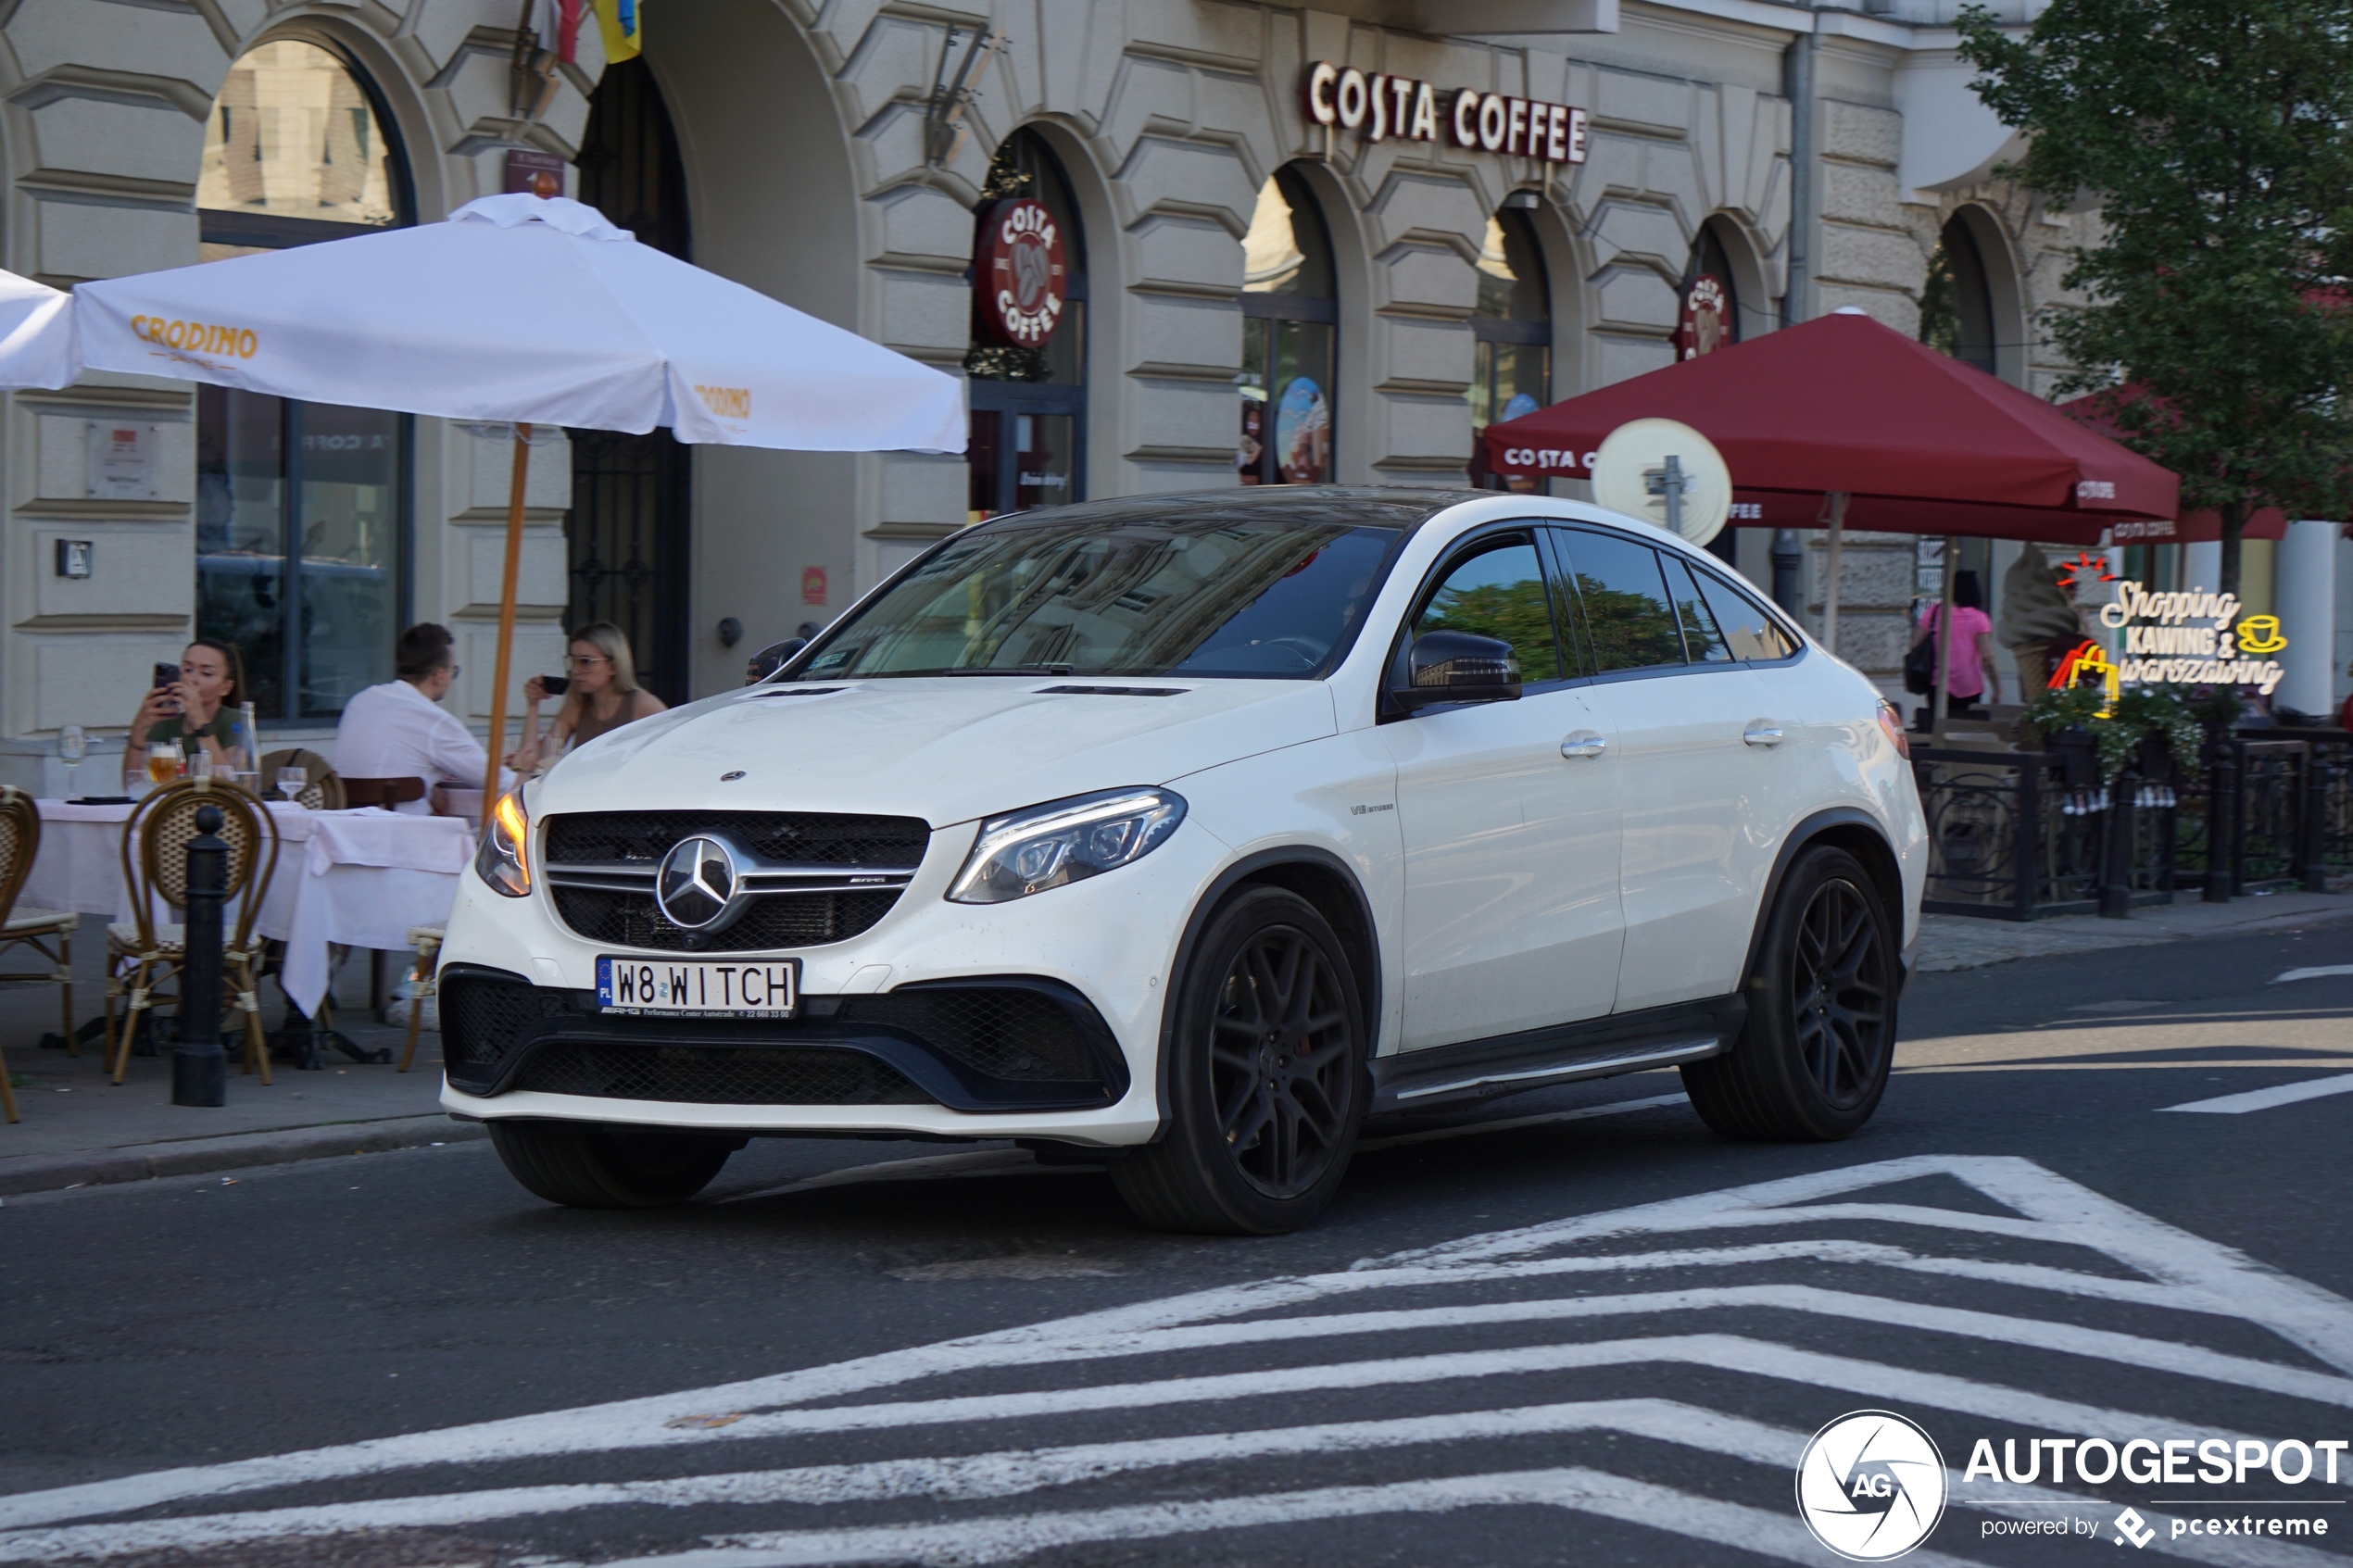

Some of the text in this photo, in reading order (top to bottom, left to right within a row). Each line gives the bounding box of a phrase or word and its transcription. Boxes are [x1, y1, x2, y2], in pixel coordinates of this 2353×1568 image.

[1308, 60, 1586, 164] COSTA COFFEE
[1001, 205, 1056, 250] COSTA
[998, 289, 1062, 341] COFFEE
[131, 314, 258, 359] CRODINO
[1504, 448, 1577, 469] COSTA
[2100, 581, 2242, 631] Shopping
[2126, 626, 2237, 659] KAWING &
[2119, 655, 2285, 696] warszawing
[599, 987, 611, 998] PL
[618, 964, 788, 1006] W8 WITCH
[643, 1008, 680, 1017] Performance
[681, 1010, 702, 1018] Center
